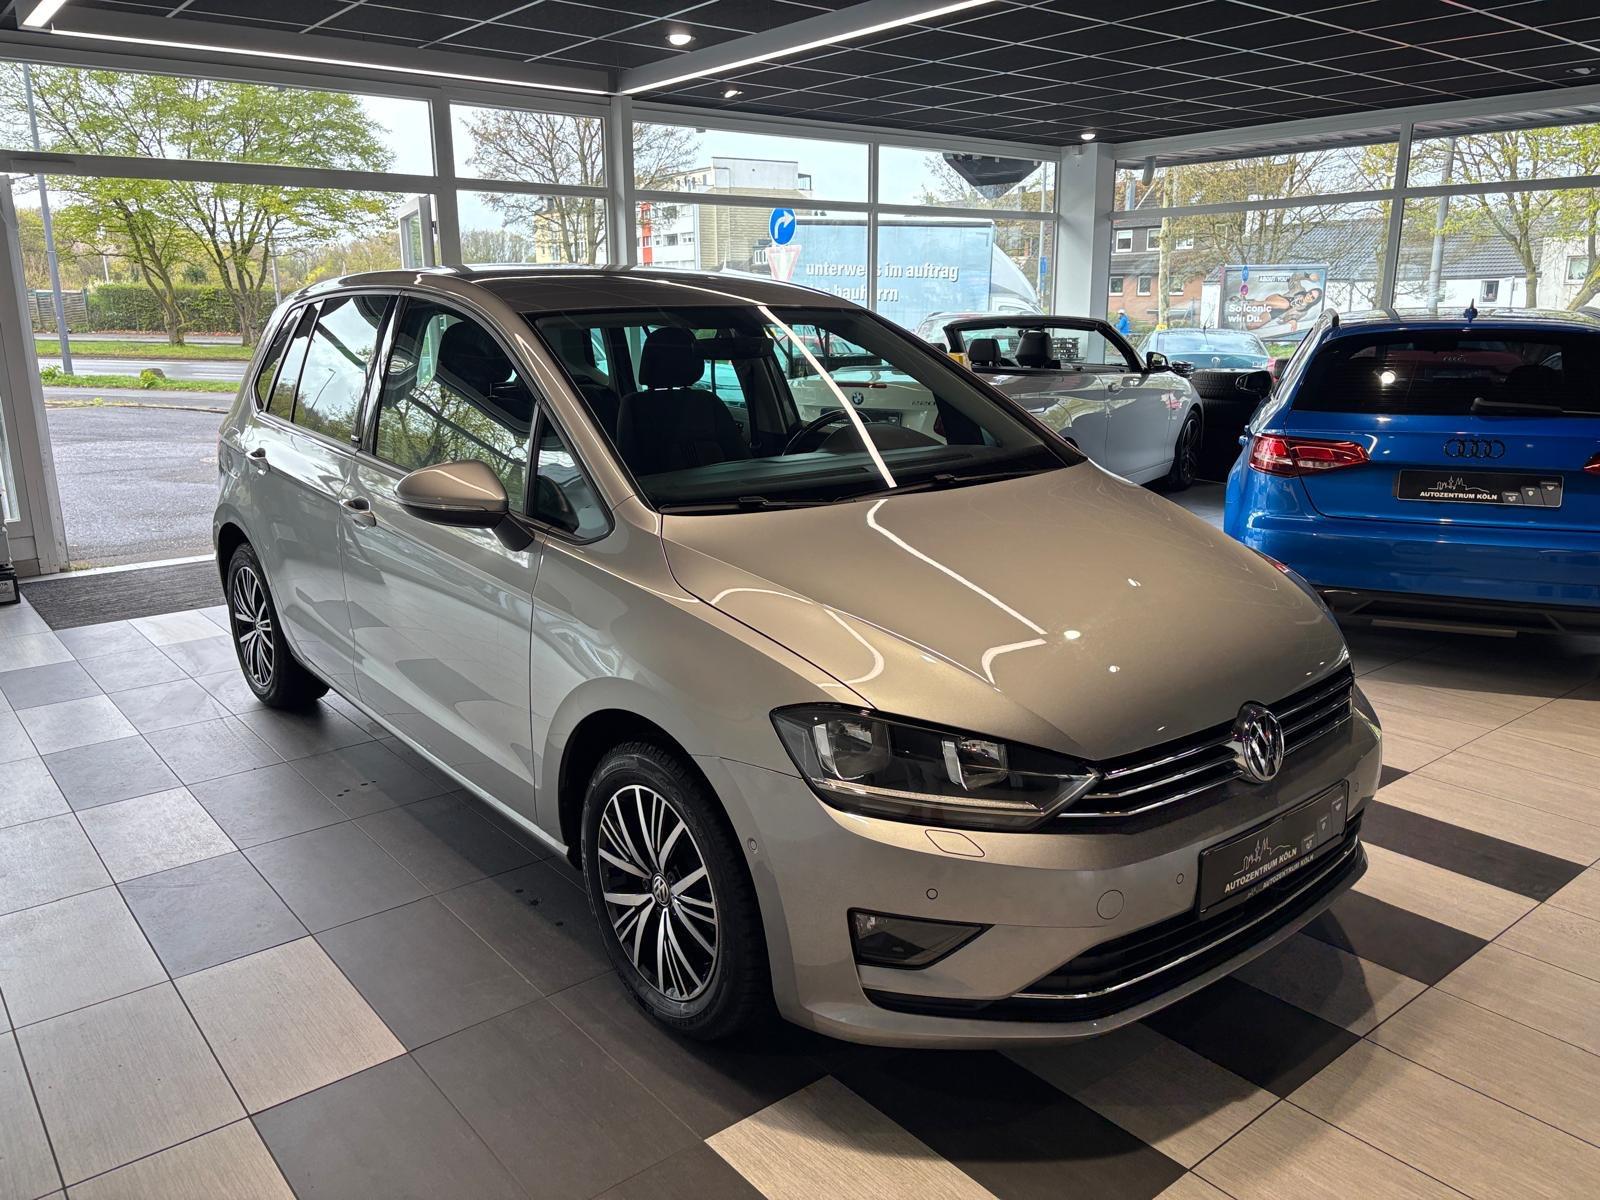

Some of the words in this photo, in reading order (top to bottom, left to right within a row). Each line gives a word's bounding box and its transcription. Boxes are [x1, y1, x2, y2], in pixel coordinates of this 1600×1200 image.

[806, 262, 881, 277] unterwes
[884, 262, 902, 278] im
[906, 263, 960, 282] auftrag
[834, 284, 899, 302] bauhrrn
[1229, 304, 1242, 312] So
[1243, 304, 1272, 312] Iconic
[1247, 314, 1262, 322] Du.
[1419, 491, 1475, 499] AUTOZENTRUM
[1477, 491, 1498, 500] KÖLN
[1224, 857, 1278, 894] AUTOZENTRUM
[1278, 847, 1298, 864] KÖLN
[1262, 860, 1300, 889] AUTOZENTRUM
